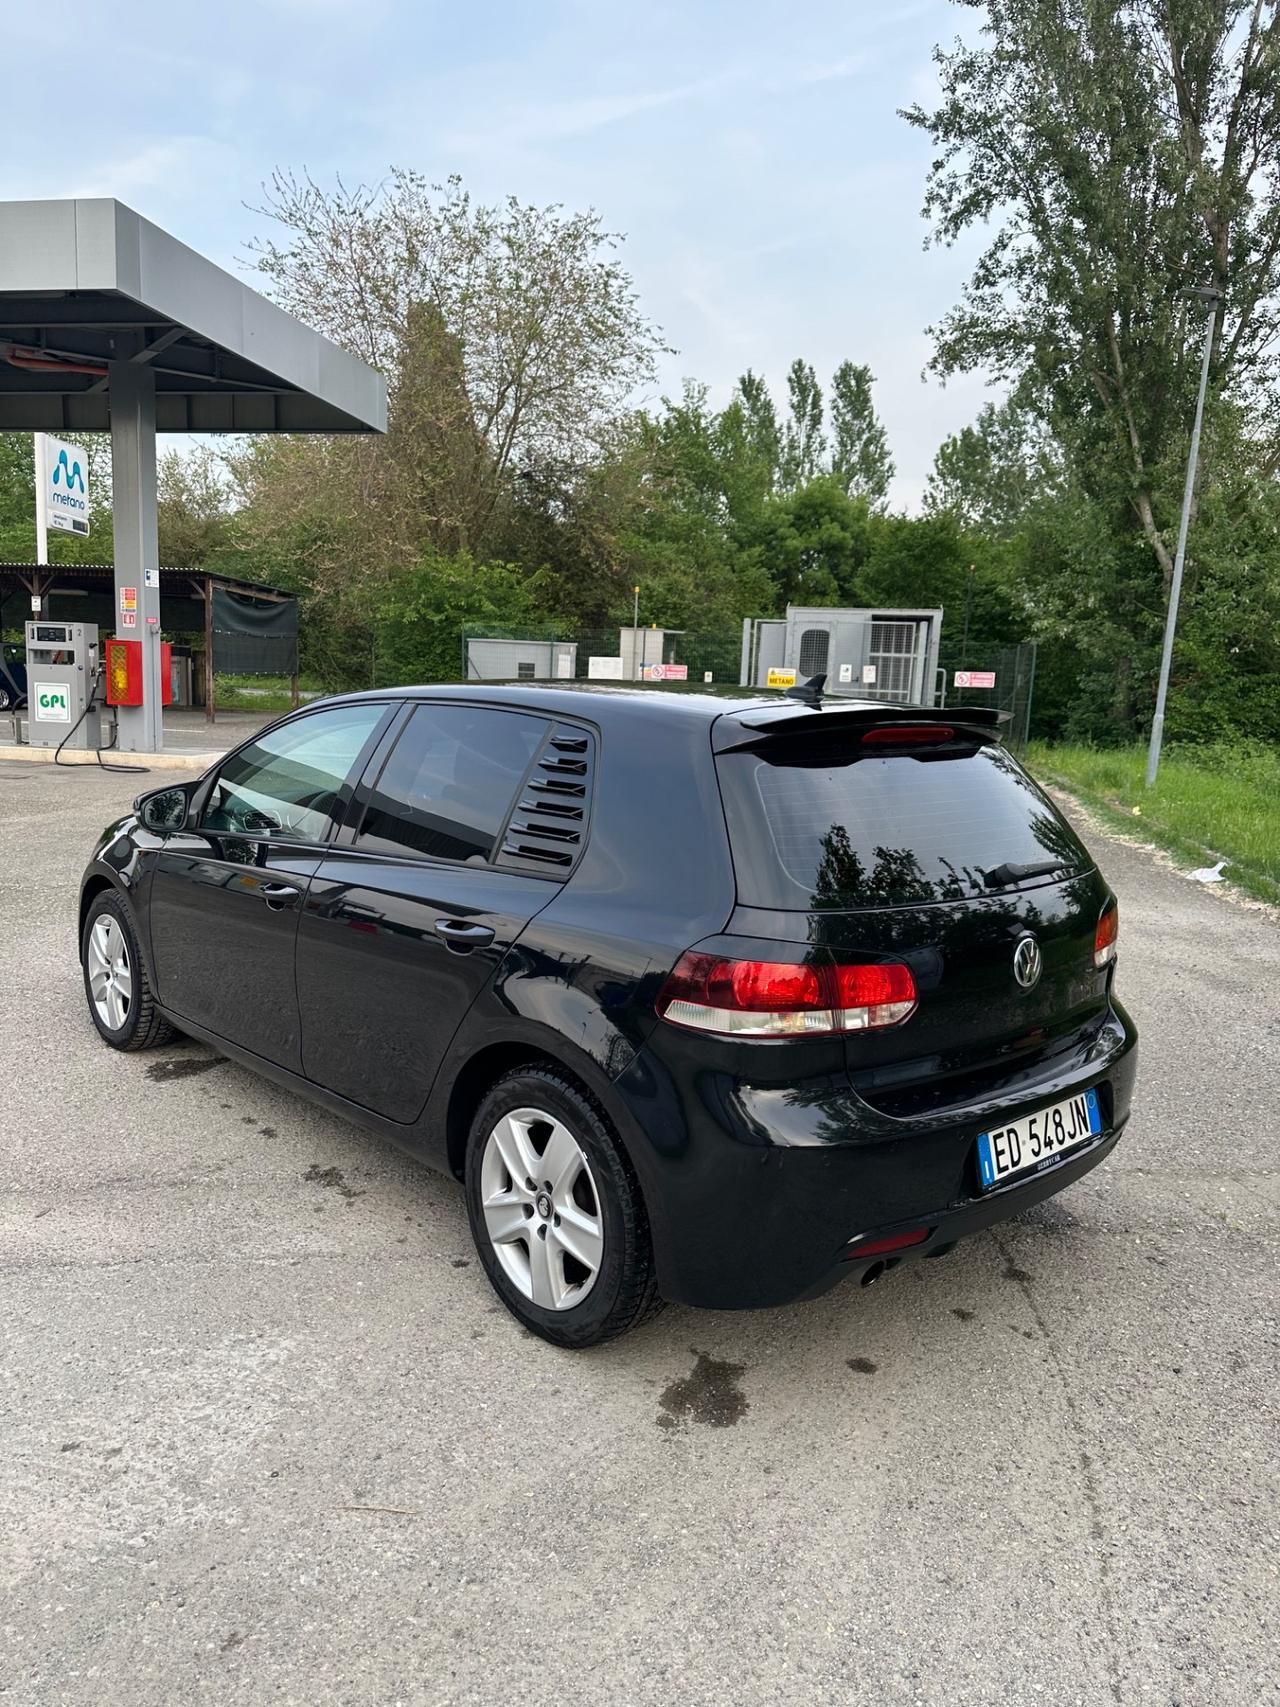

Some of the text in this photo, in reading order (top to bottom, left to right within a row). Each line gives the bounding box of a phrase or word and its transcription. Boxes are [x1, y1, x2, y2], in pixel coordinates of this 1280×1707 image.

[53, 493, 85, 510] metano
[769, 677, 794, 685] METANO
[40, 694, 66, 709] GPL
[993, 1128, 1021, 1174] ED
